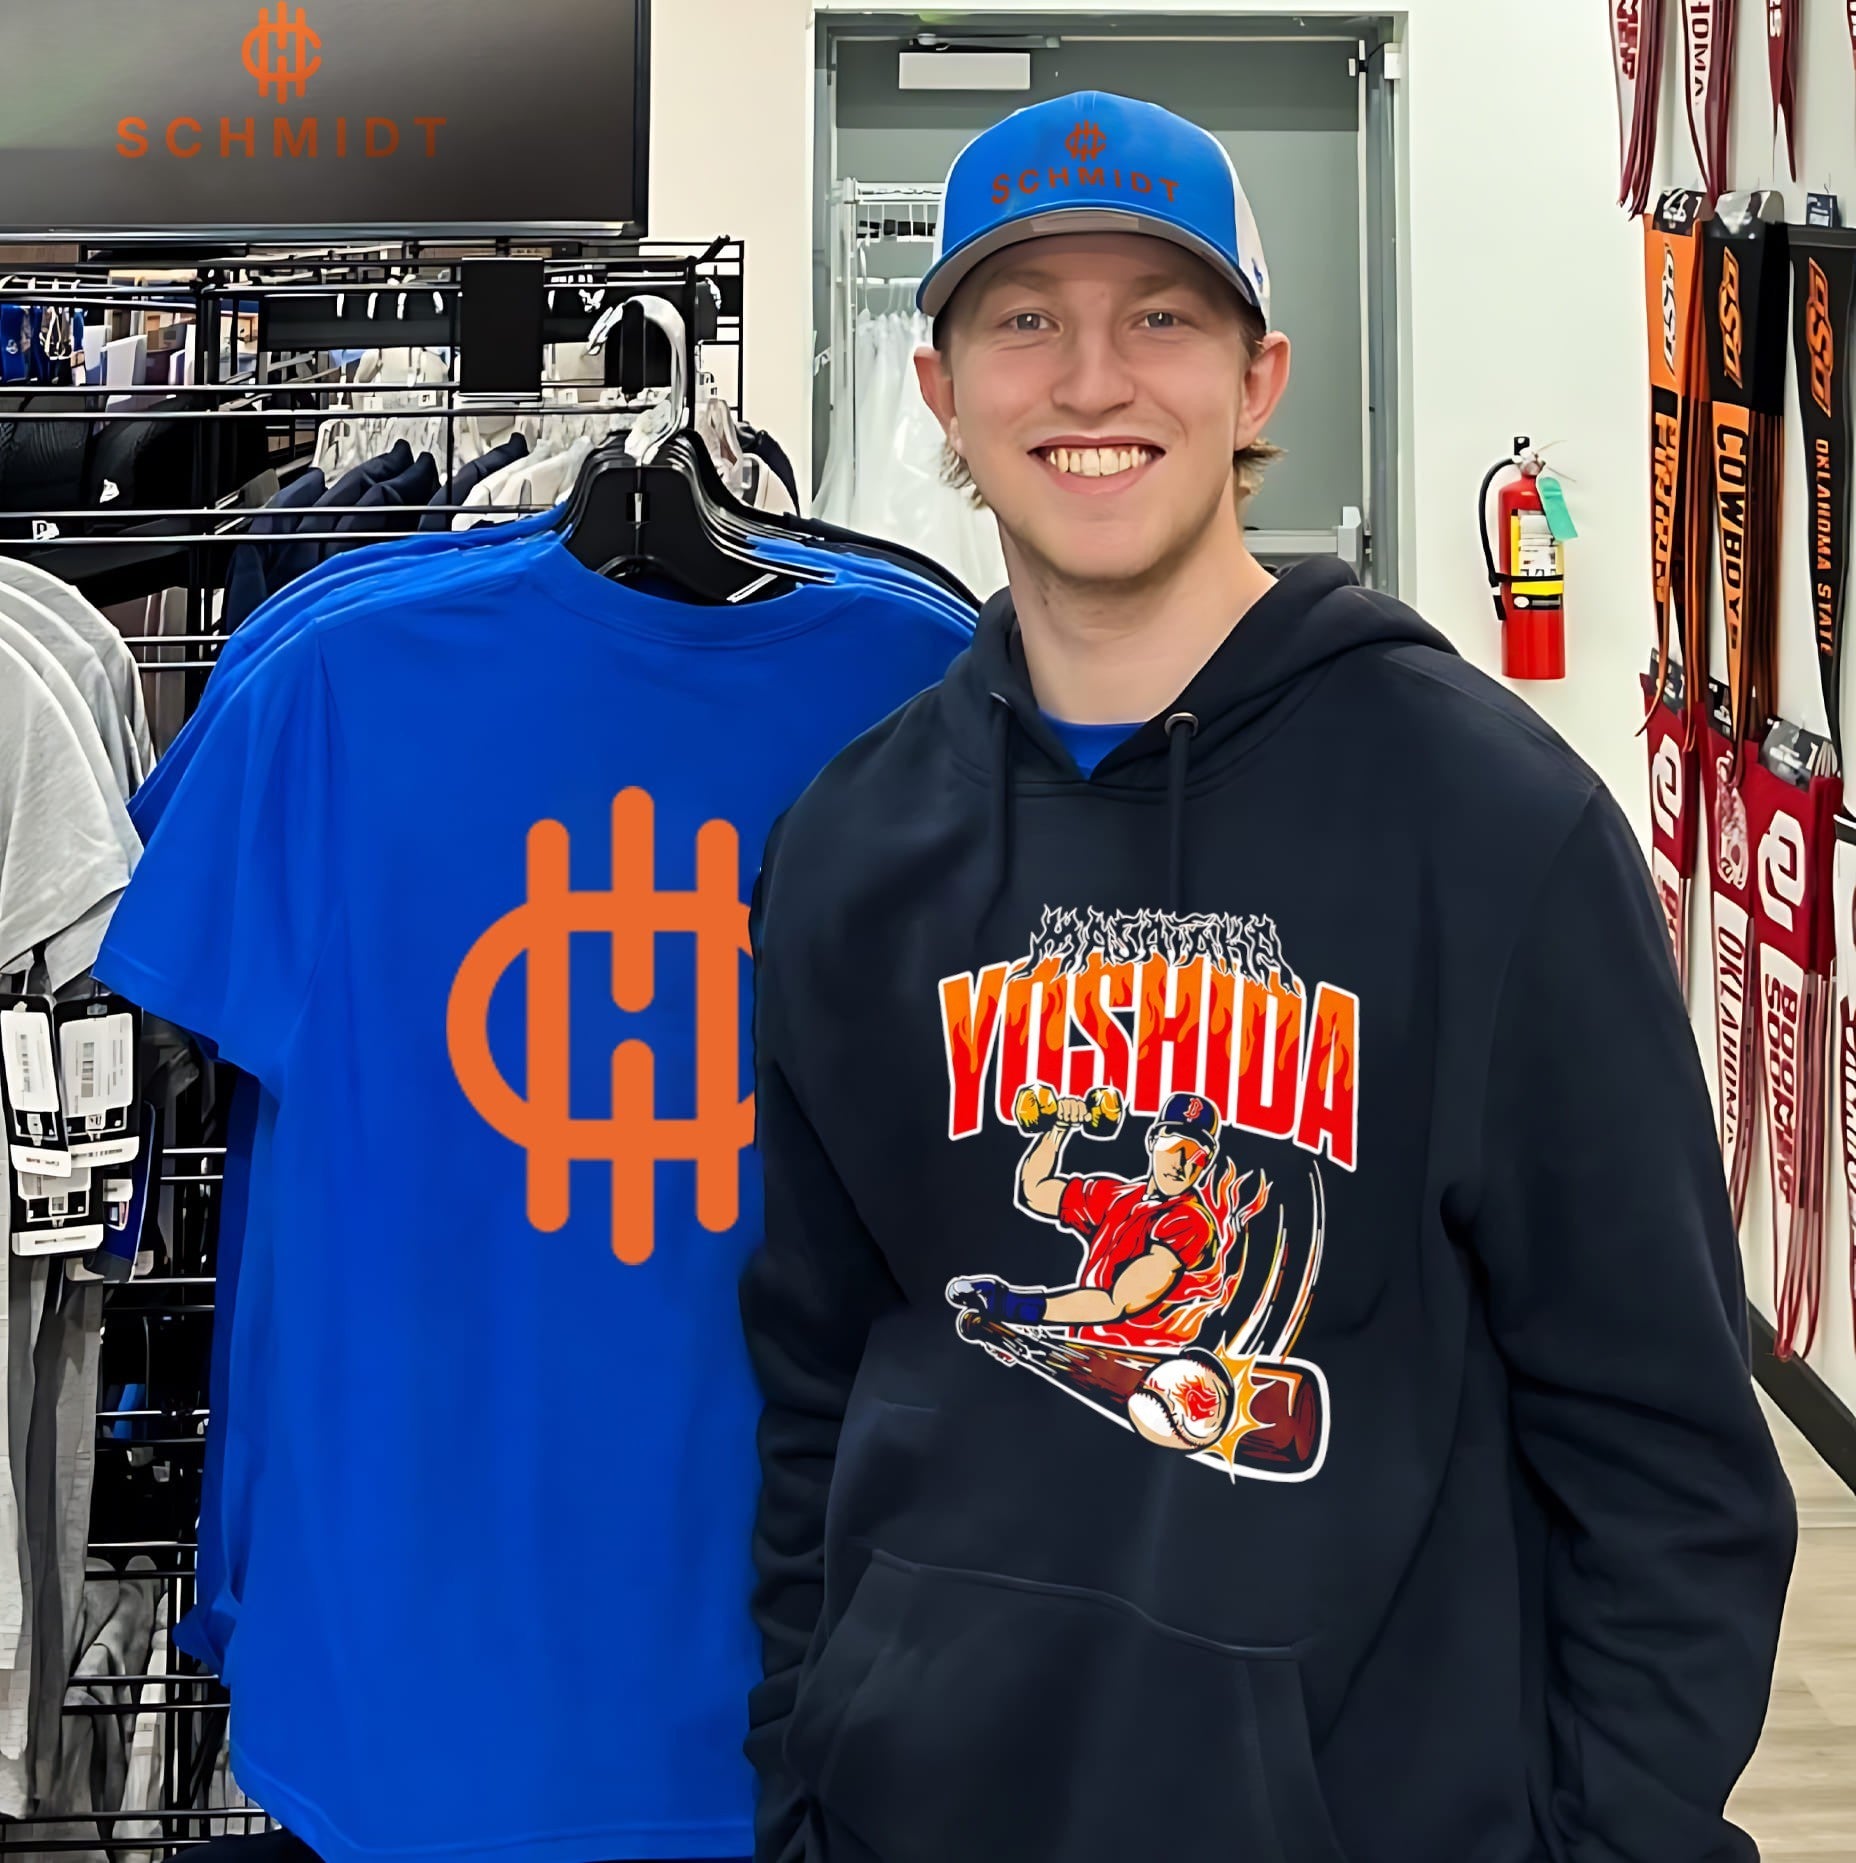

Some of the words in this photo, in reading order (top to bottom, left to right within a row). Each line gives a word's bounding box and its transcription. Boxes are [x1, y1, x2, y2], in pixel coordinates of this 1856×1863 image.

[116, 117, 448, 158] SCHMIDT
[991, 167, 1179, 205] SCHMIDT
[938, 946, 1360, 1172] YOSHIDA
